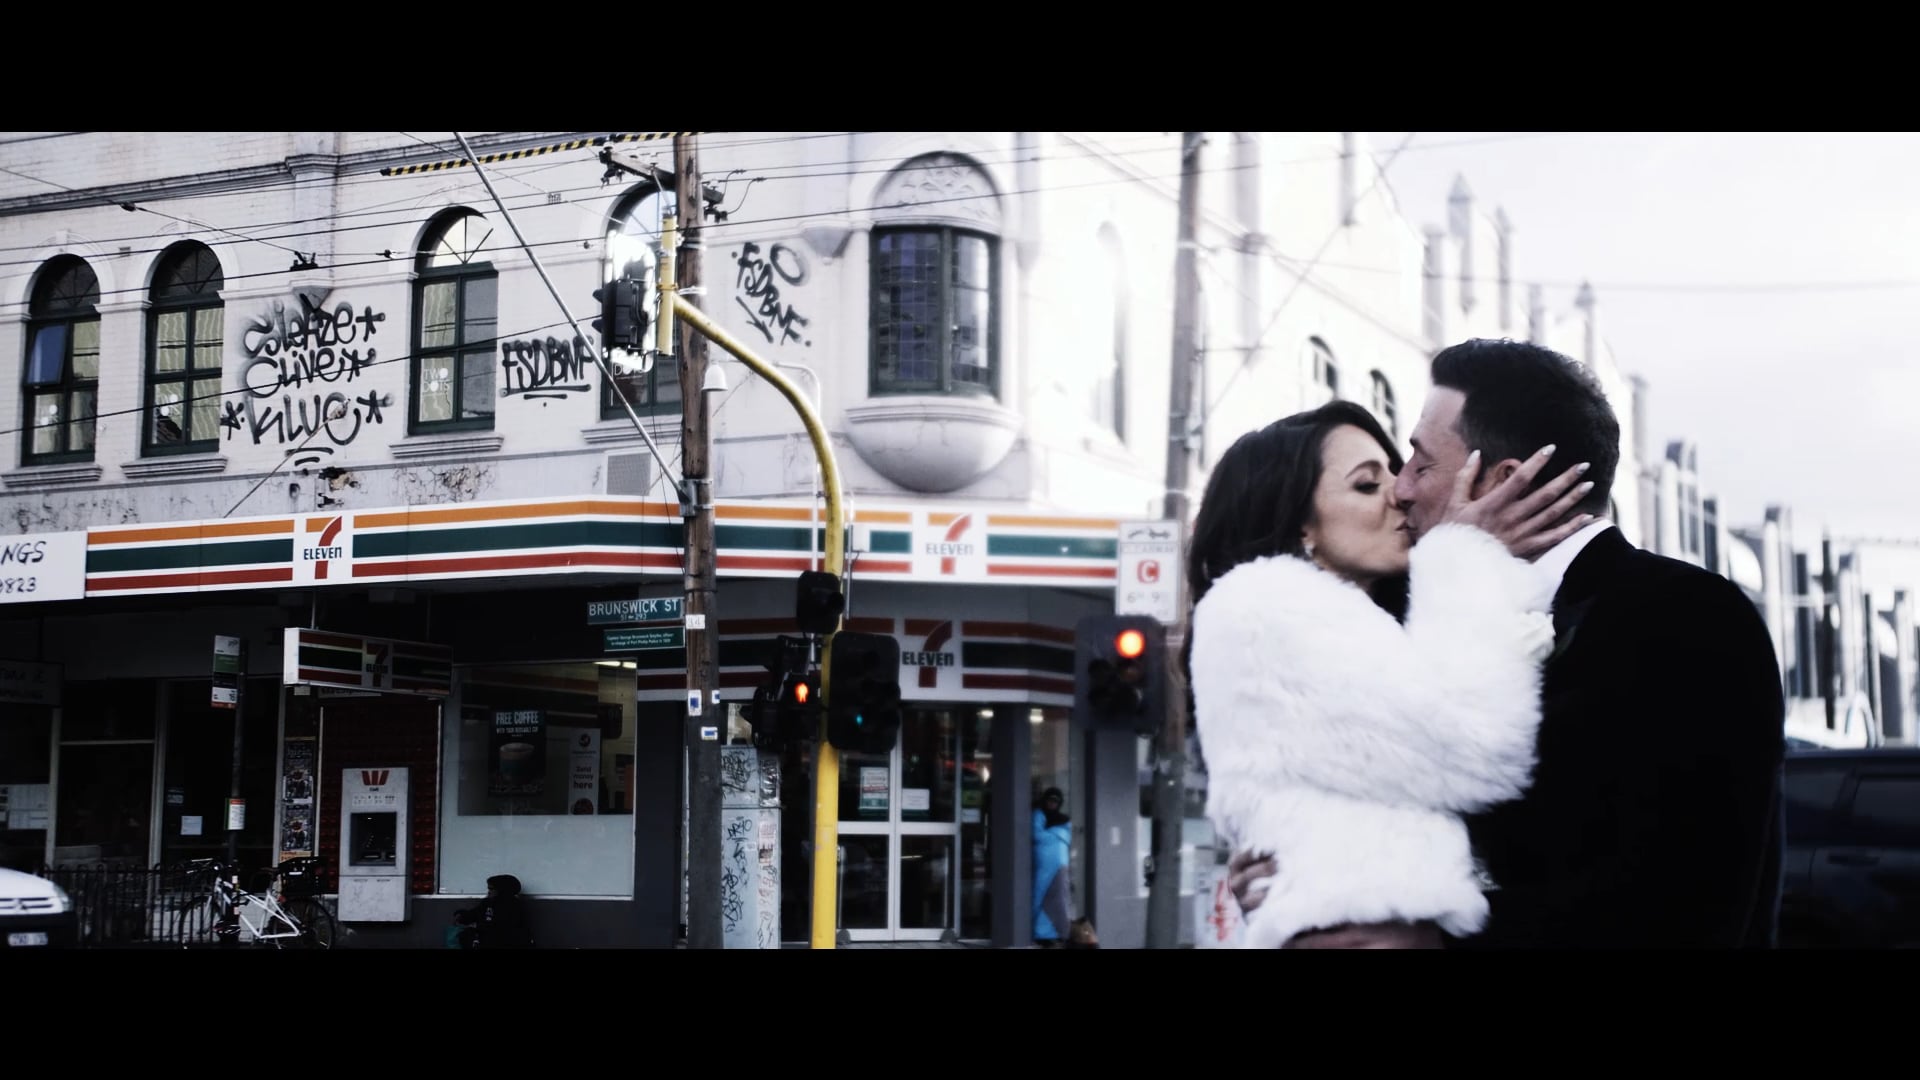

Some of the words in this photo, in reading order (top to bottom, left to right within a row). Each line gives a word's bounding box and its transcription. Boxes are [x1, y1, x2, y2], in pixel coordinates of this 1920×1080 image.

[588, 600, 658, 617] BRUNSWICK
[664, 599, 679, 612] ST
[496, 711, 513, 726] FREE
[514, 710, 540, 725] COFFEE
[573, 782, 593, 790] here
